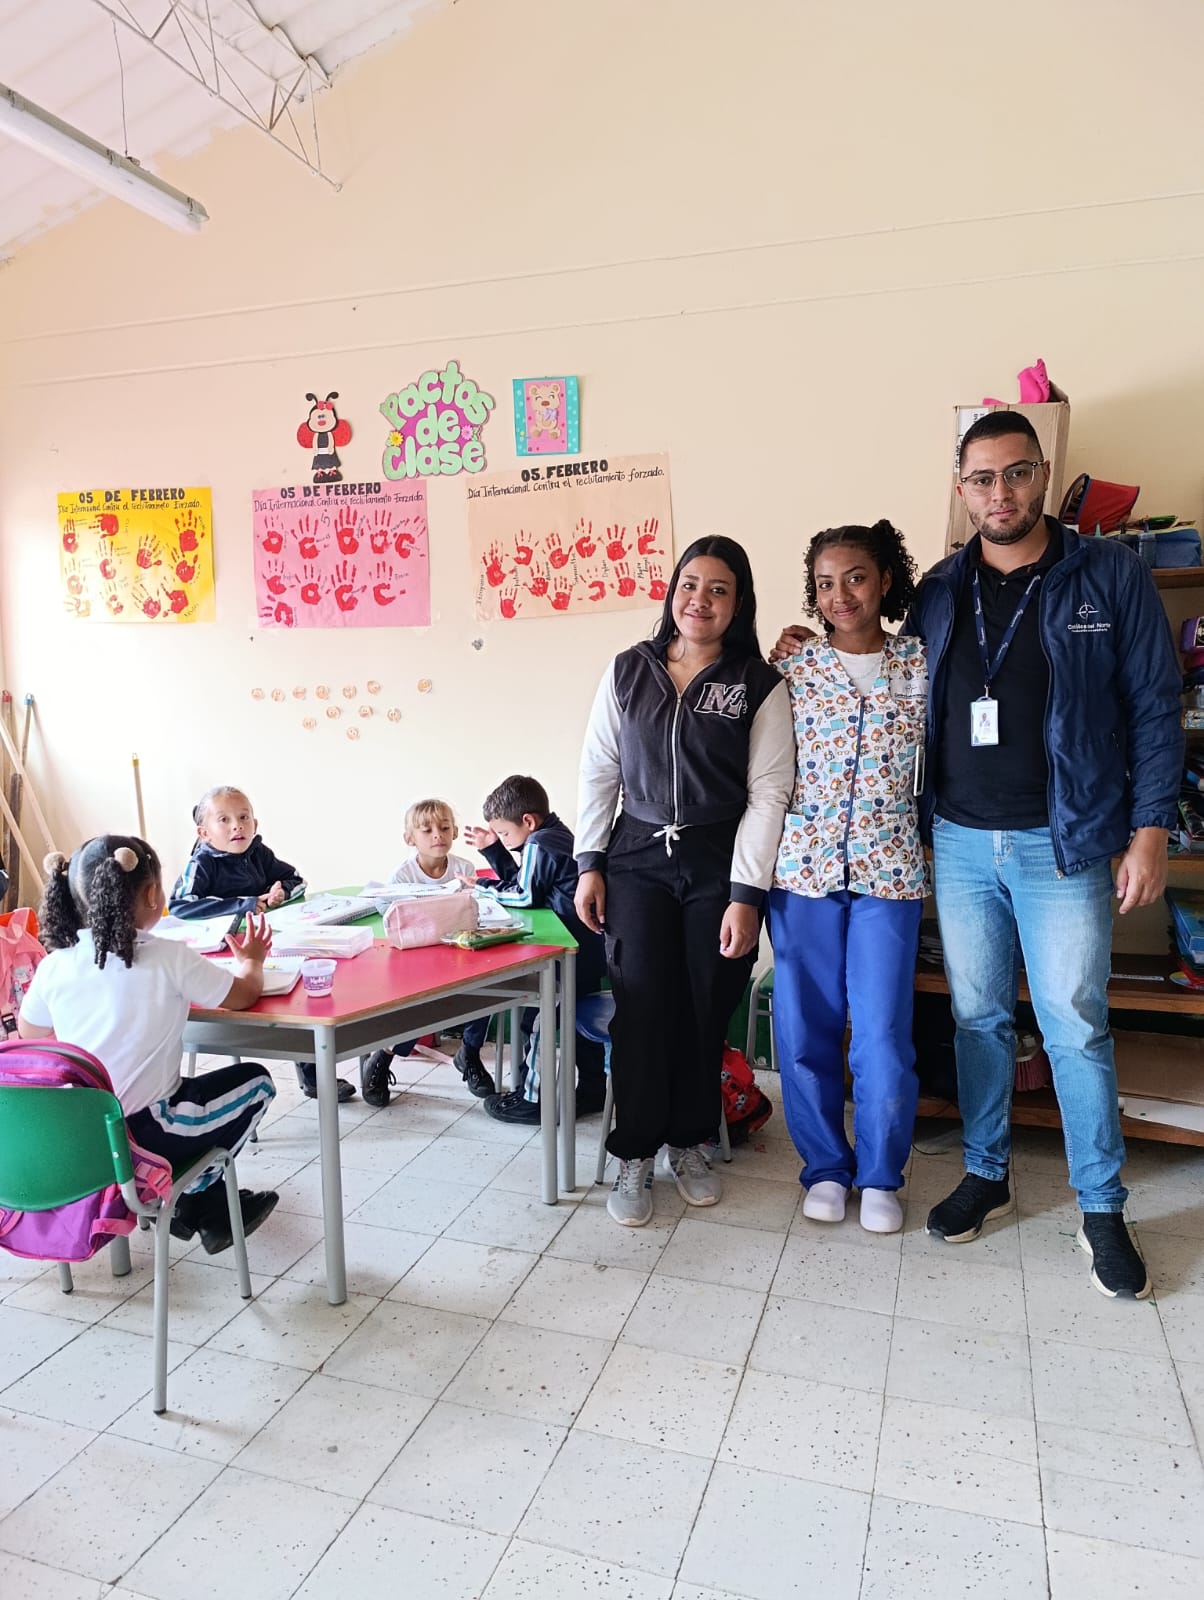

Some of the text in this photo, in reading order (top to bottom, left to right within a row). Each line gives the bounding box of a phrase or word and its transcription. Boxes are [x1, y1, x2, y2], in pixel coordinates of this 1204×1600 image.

[416, 403, 460, 446] de
[546, 459, 608, 479] FEBRERO
[281, 482, 381, 499] 05 DE FEBRERO
[480, 483, 530, 498] Internacional
[562, 478, 571, 488] el
[576, 470, 625, 486] reclutamiento
[79, 487, 185, 504] 05 DE FEBRERO
[267, 497, 315, 512] Internacional
